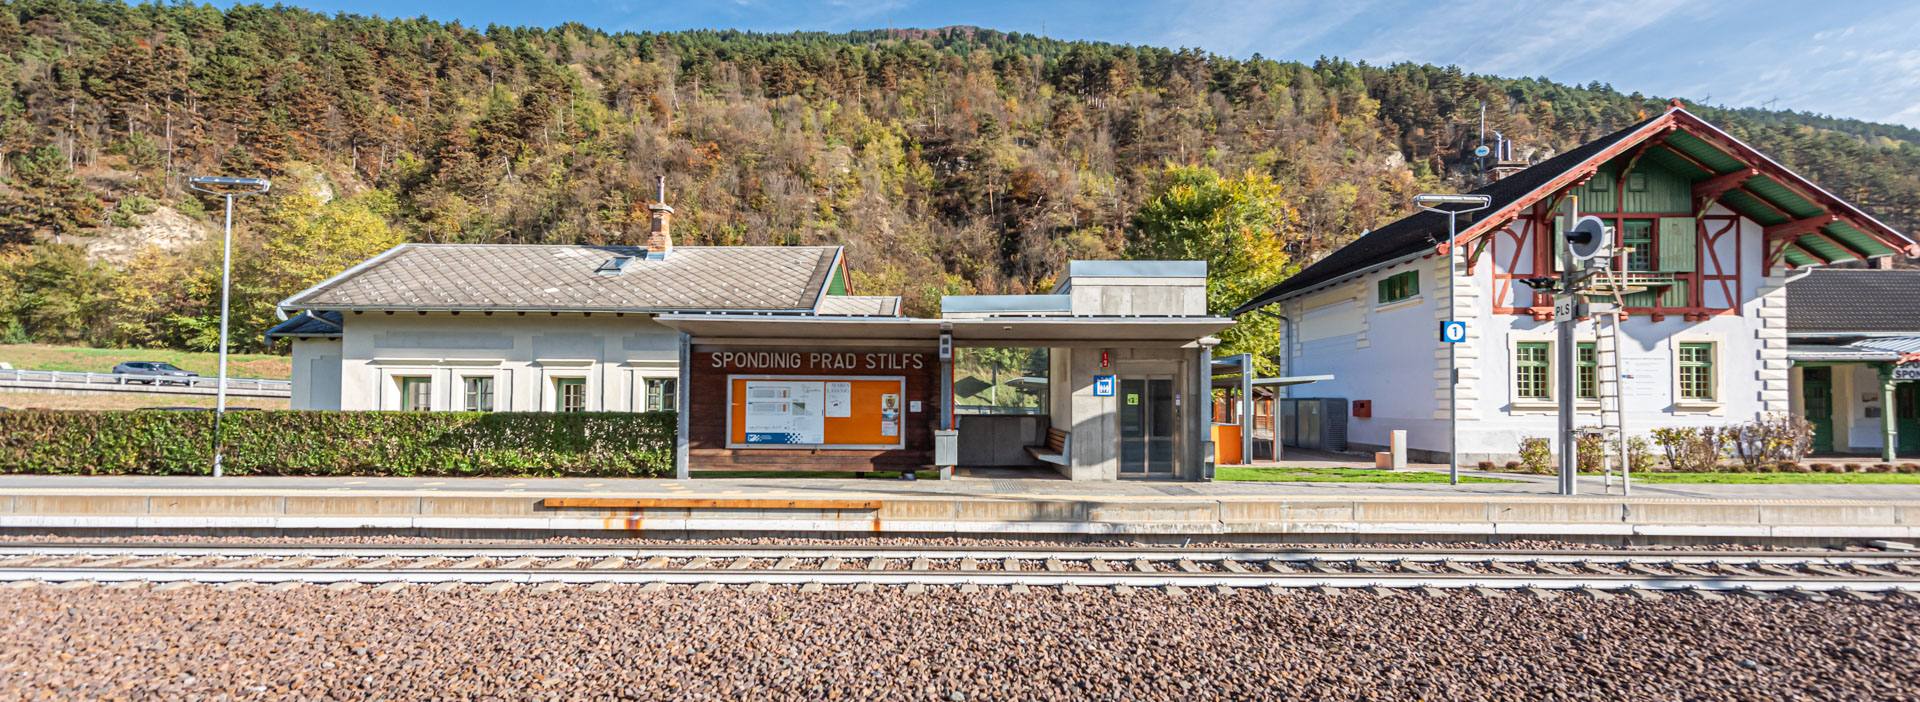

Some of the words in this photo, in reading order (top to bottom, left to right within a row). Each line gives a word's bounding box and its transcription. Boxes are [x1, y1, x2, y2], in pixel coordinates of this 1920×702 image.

[1556, 303, 1570, 316] PLS
[1453, 327, 1457, 337] 1
[711, 352, 801, 368] SPONDINIG
[810, 353, 857, 369] PRAD
[865, 353, 924, 369] STILFS
